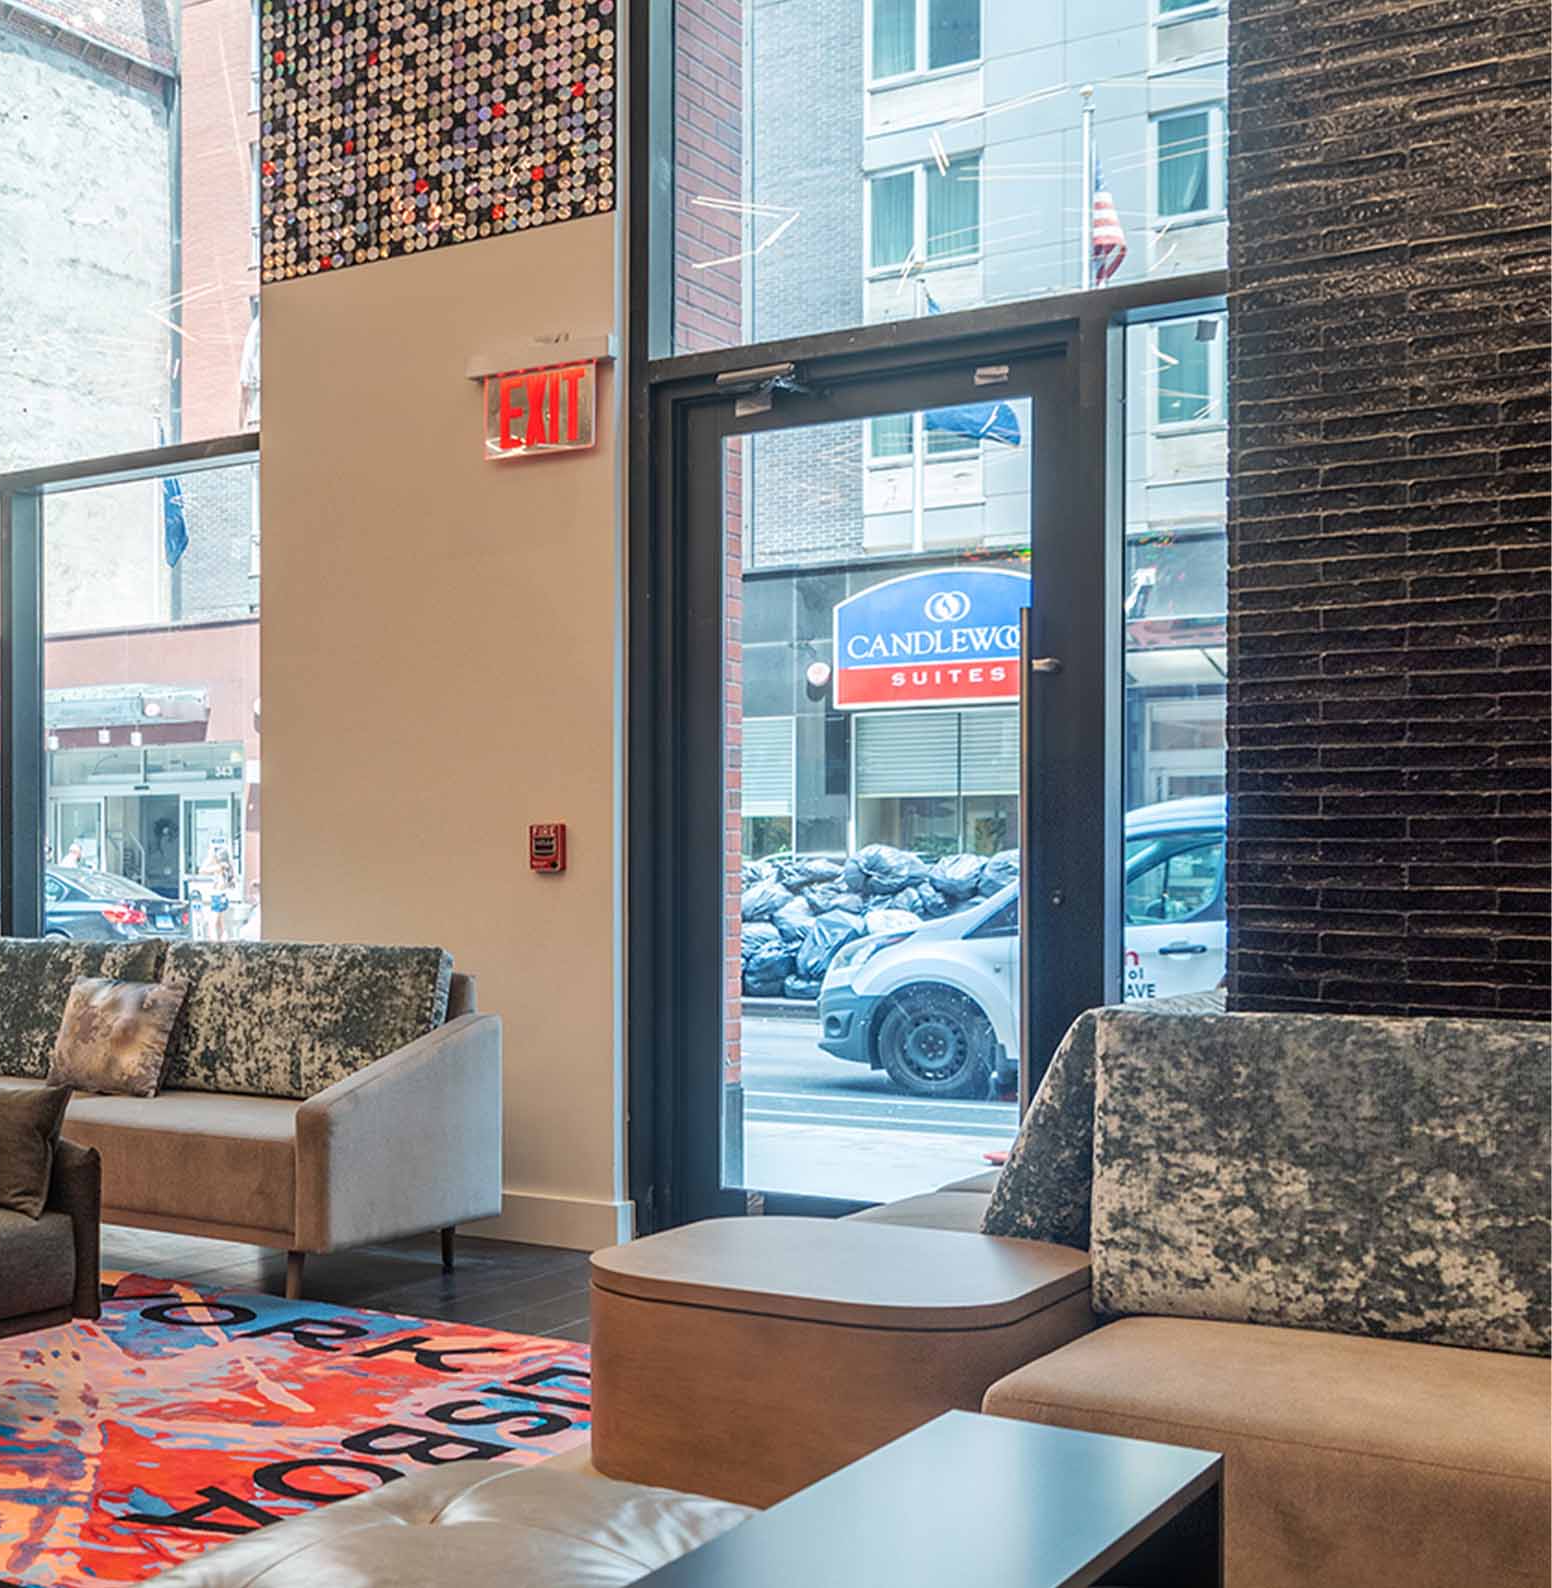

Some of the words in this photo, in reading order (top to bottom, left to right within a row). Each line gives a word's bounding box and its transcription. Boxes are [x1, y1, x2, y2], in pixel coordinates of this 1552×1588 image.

[499, 367, 585, 450] EXIT
[848, 624, 1021, 659] CANDLEWOO
[891, 667, 1006, 687] SUITES
